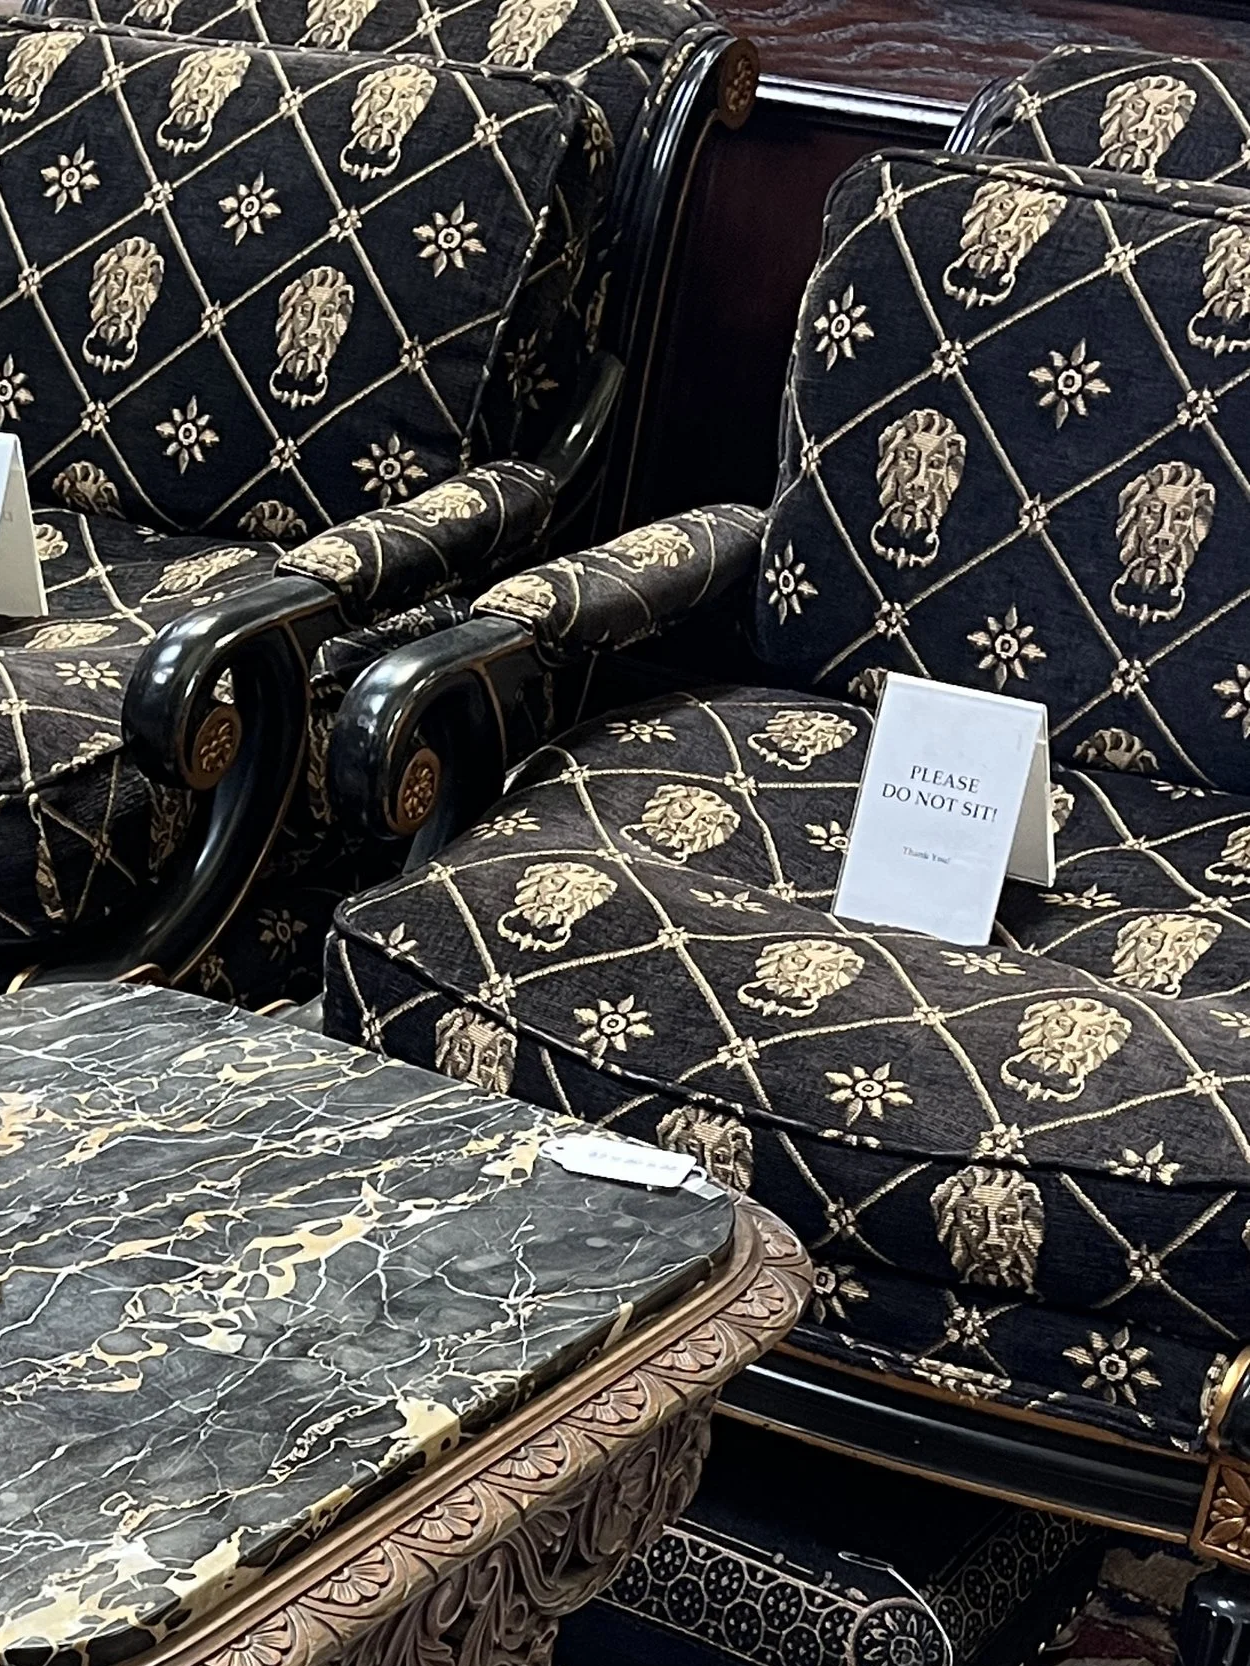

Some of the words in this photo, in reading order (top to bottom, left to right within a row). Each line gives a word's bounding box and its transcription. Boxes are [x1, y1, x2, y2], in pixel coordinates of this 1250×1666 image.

[910, 765, 981, 793] PLEASE
[882, 783, 911, 802] DO
[914, 790, 958, 812] NOT
[961, 801, 998, 823] SIT!
[902, 846, 929, 860] Thank
